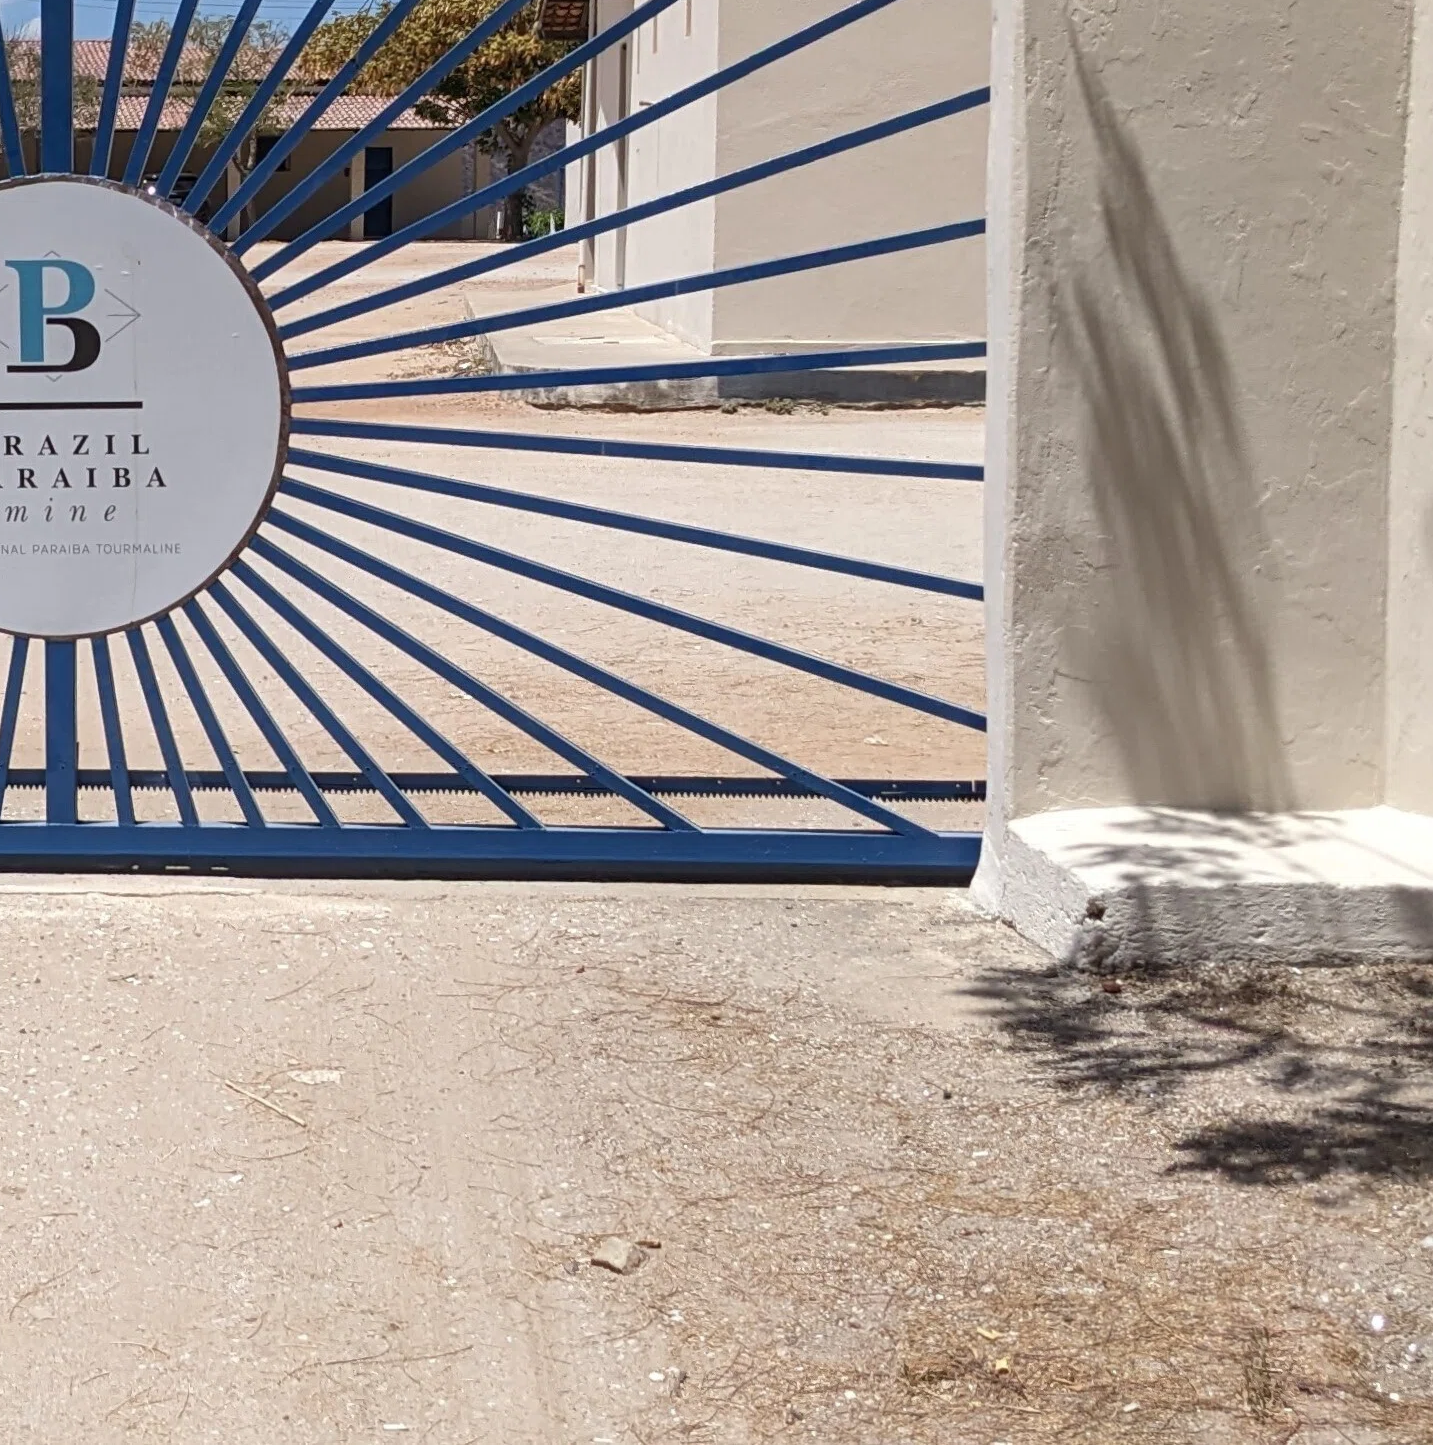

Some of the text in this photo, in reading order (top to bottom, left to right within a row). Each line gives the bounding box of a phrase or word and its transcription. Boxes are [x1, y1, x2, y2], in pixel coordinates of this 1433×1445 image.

[5, 497, 117, 523] mine
[32, 544, 90, 555] PARAIBA
[96, 543, 181, 555] TOURMALINE
